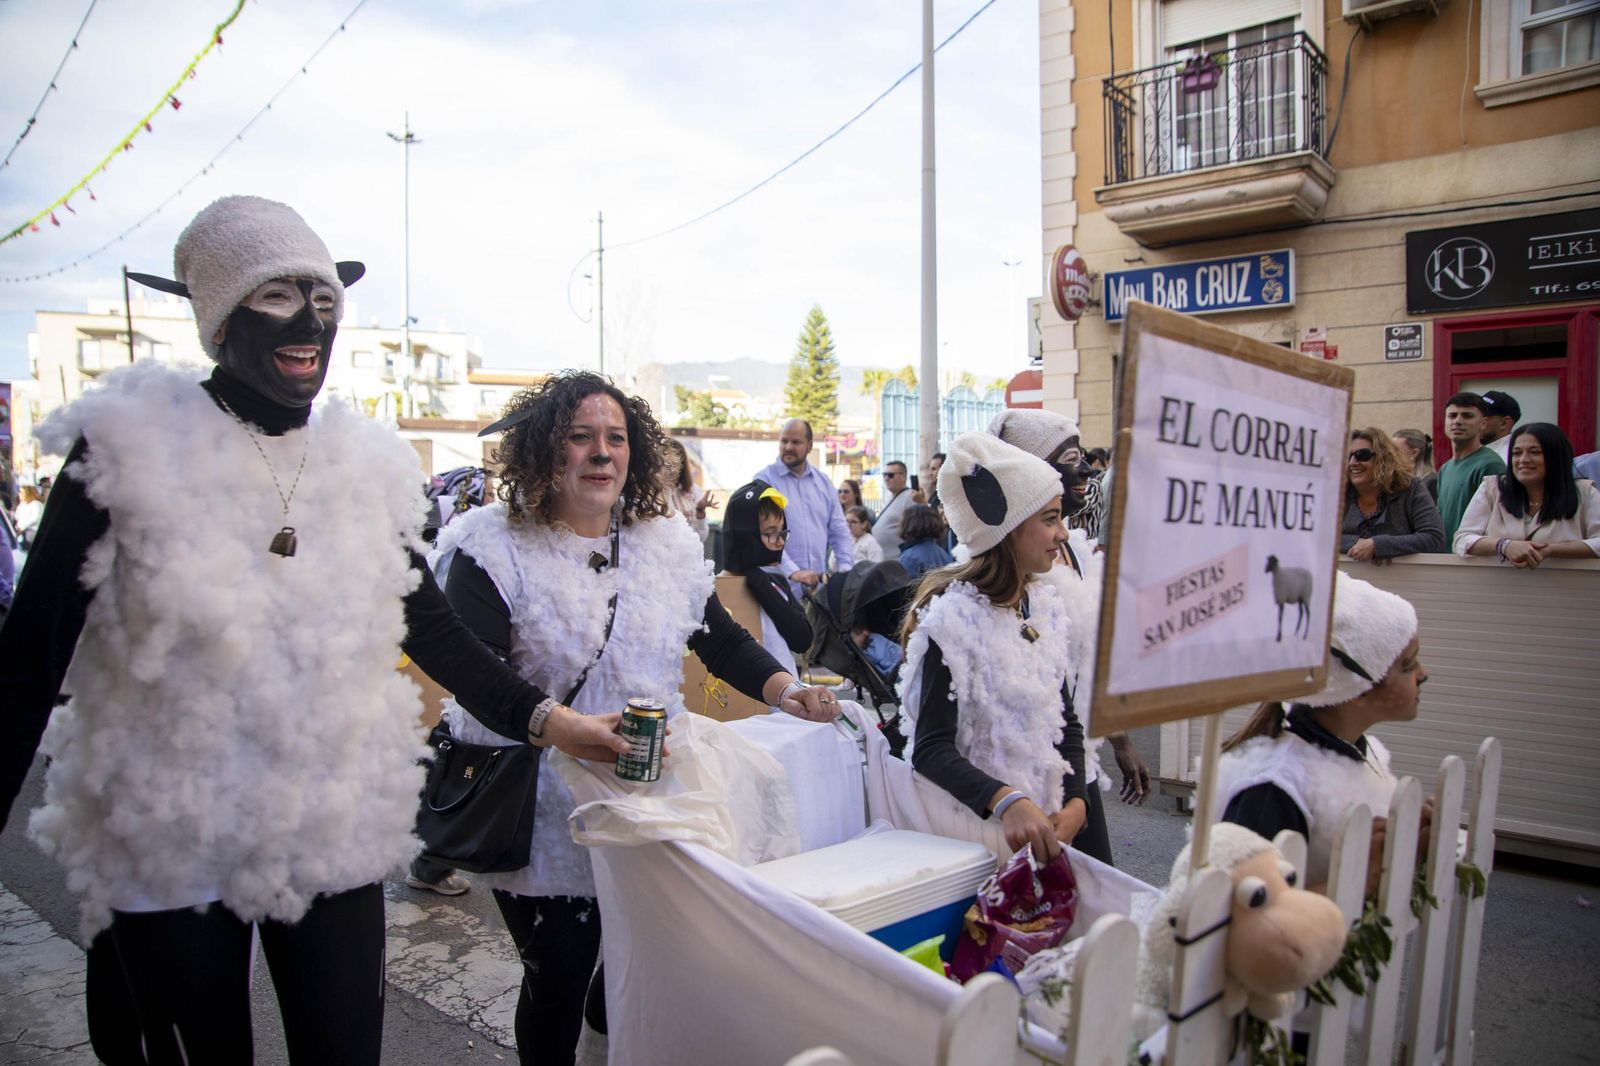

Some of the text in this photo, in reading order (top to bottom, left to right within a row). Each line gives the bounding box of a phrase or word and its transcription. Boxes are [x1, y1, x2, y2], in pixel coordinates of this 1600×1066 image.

[1195, 261, 1252, 307] CRUZ
[1157, 396, 1323, 469] EL CORRAL
[1163, 477, 1315, 532] DE MANUÉ
[1165, 560, 1226, 607] FIESTAS
[1143, 615, 1176, 649] SAN
[1177, 591, 1216, 632] JOSÉ
